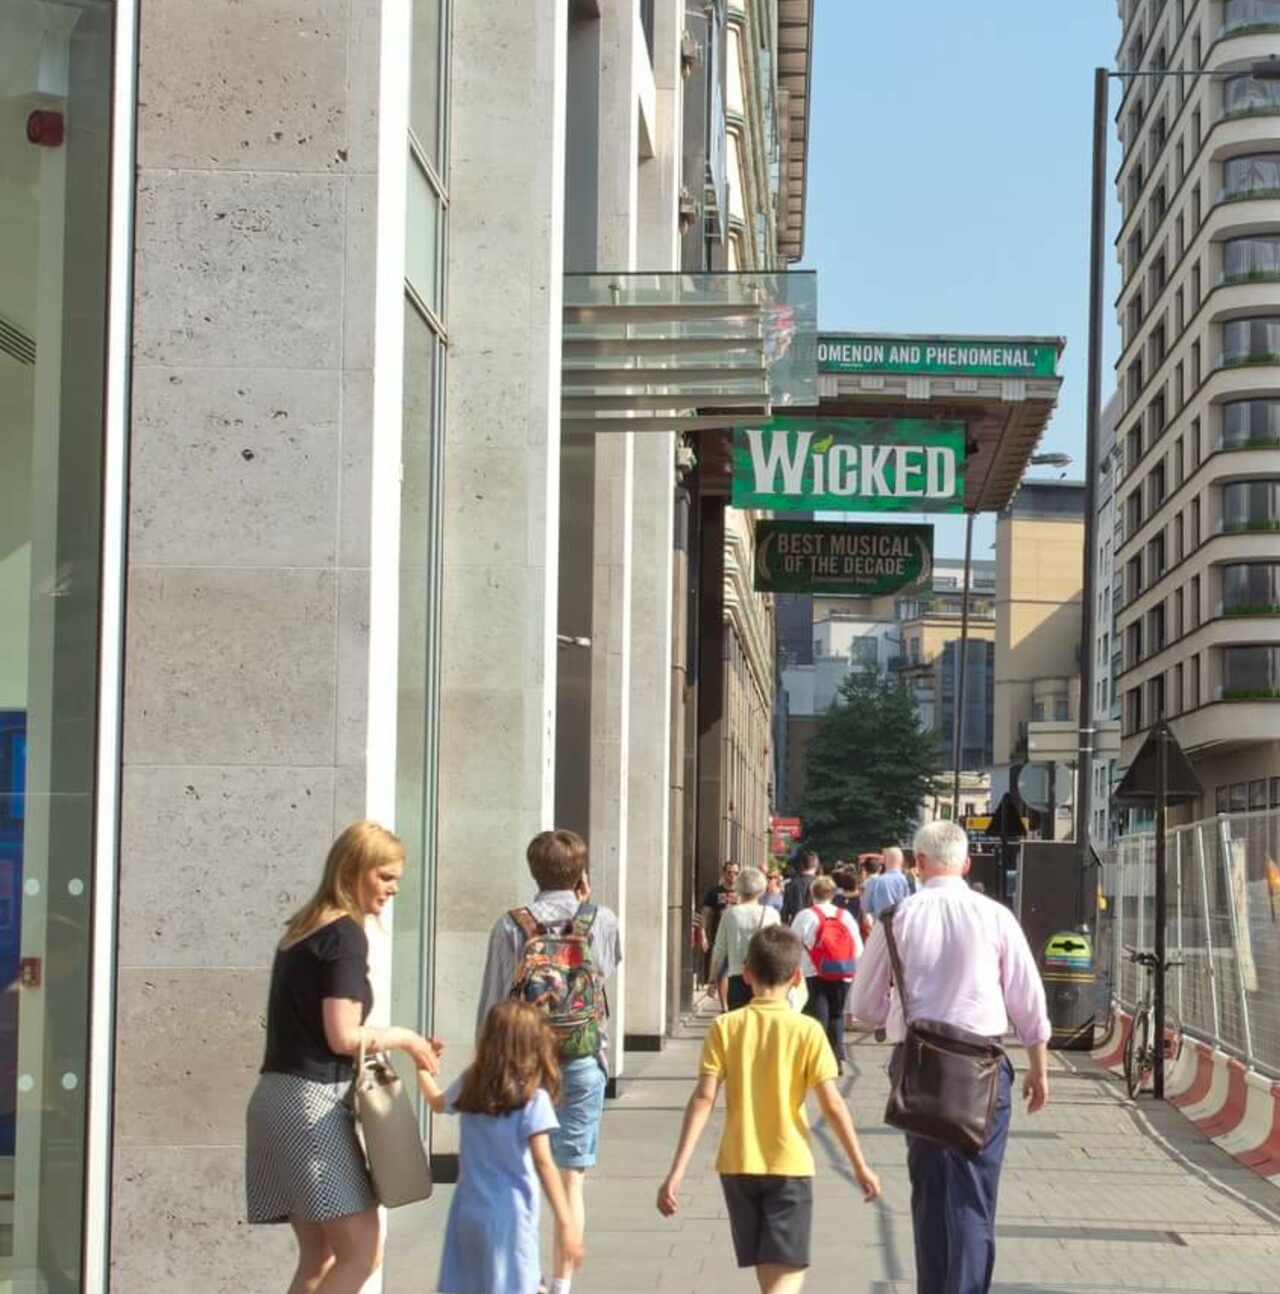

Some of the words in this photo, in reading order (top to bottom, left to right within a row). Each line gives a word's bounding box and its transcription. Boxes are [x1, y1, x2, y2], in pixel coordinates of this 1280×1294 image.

[816, 344, 884, 364] OMENON
[889, 345, 921, 364] AND
[777, 533, 825, 554] BEST
[829, 534, 914, 557] MUSICAL
[784, 555, 806, 573] OF
[810, 556, 839, 574] THE
[843, 557, 906, 576] DECADE
